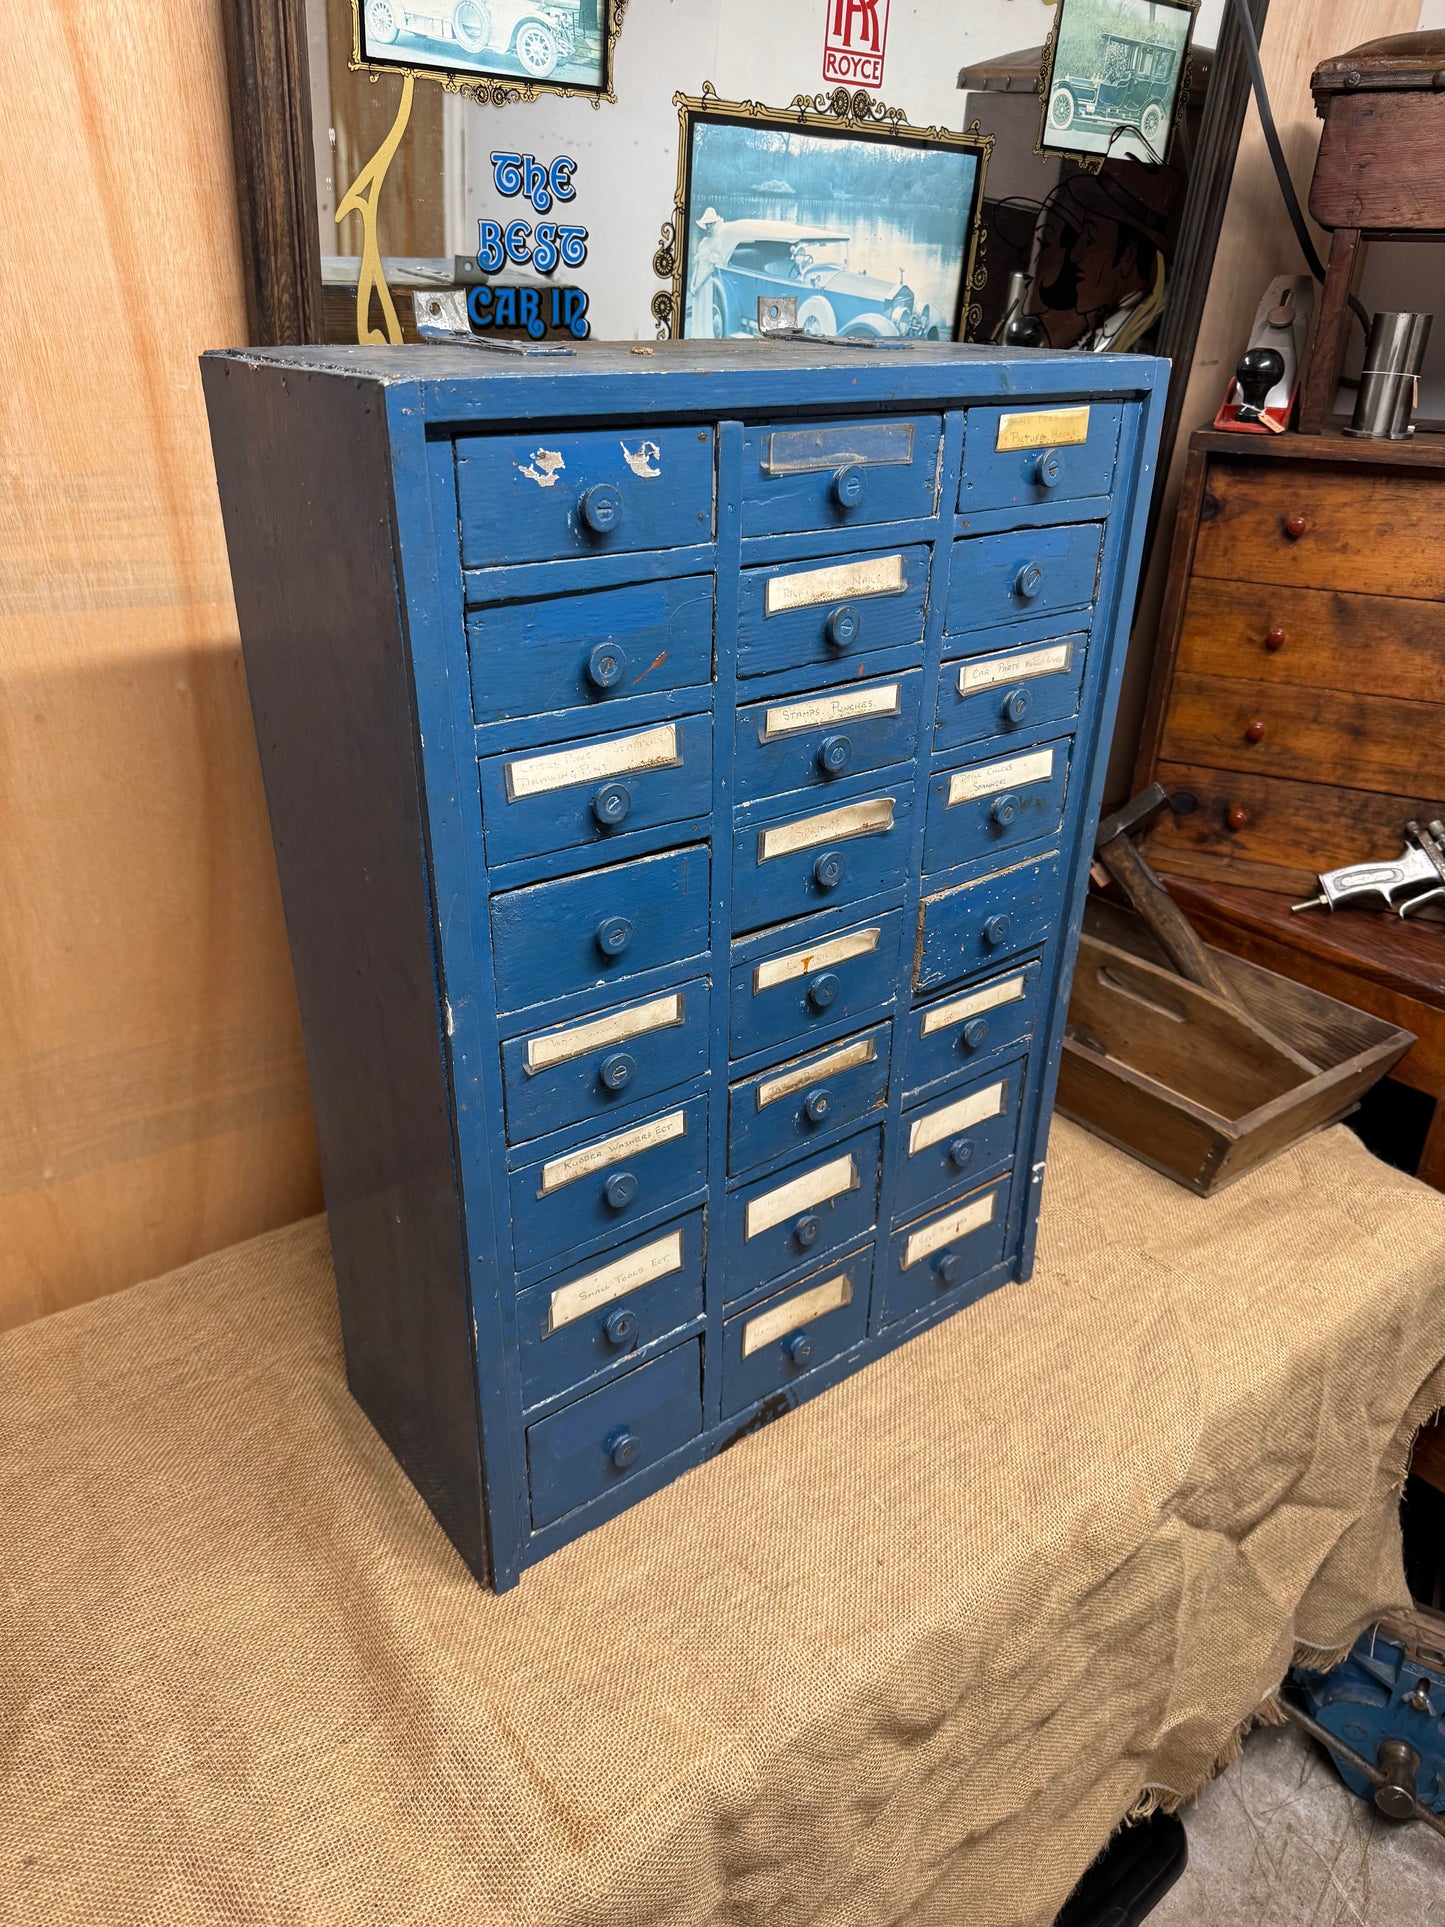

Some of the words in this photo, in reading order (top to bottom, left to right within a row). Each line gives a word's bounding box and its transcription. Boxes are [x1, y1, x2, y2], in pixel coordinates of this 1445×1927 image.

[826, 52, 881, 80] ROYCE
[477, 219, 589, 275] BEST
[467, 284, 547, 340] CAR
[551, 285, 591, 341] IN
[972, 668, 991, 680] CAR
[997, 662, 1020, 674] PARTS
[563, 1151, 603, 1171] RUBBER
[608, 1131, 653, 1154] WASHERS
[578, 1284, 611, 1302] SMALL
